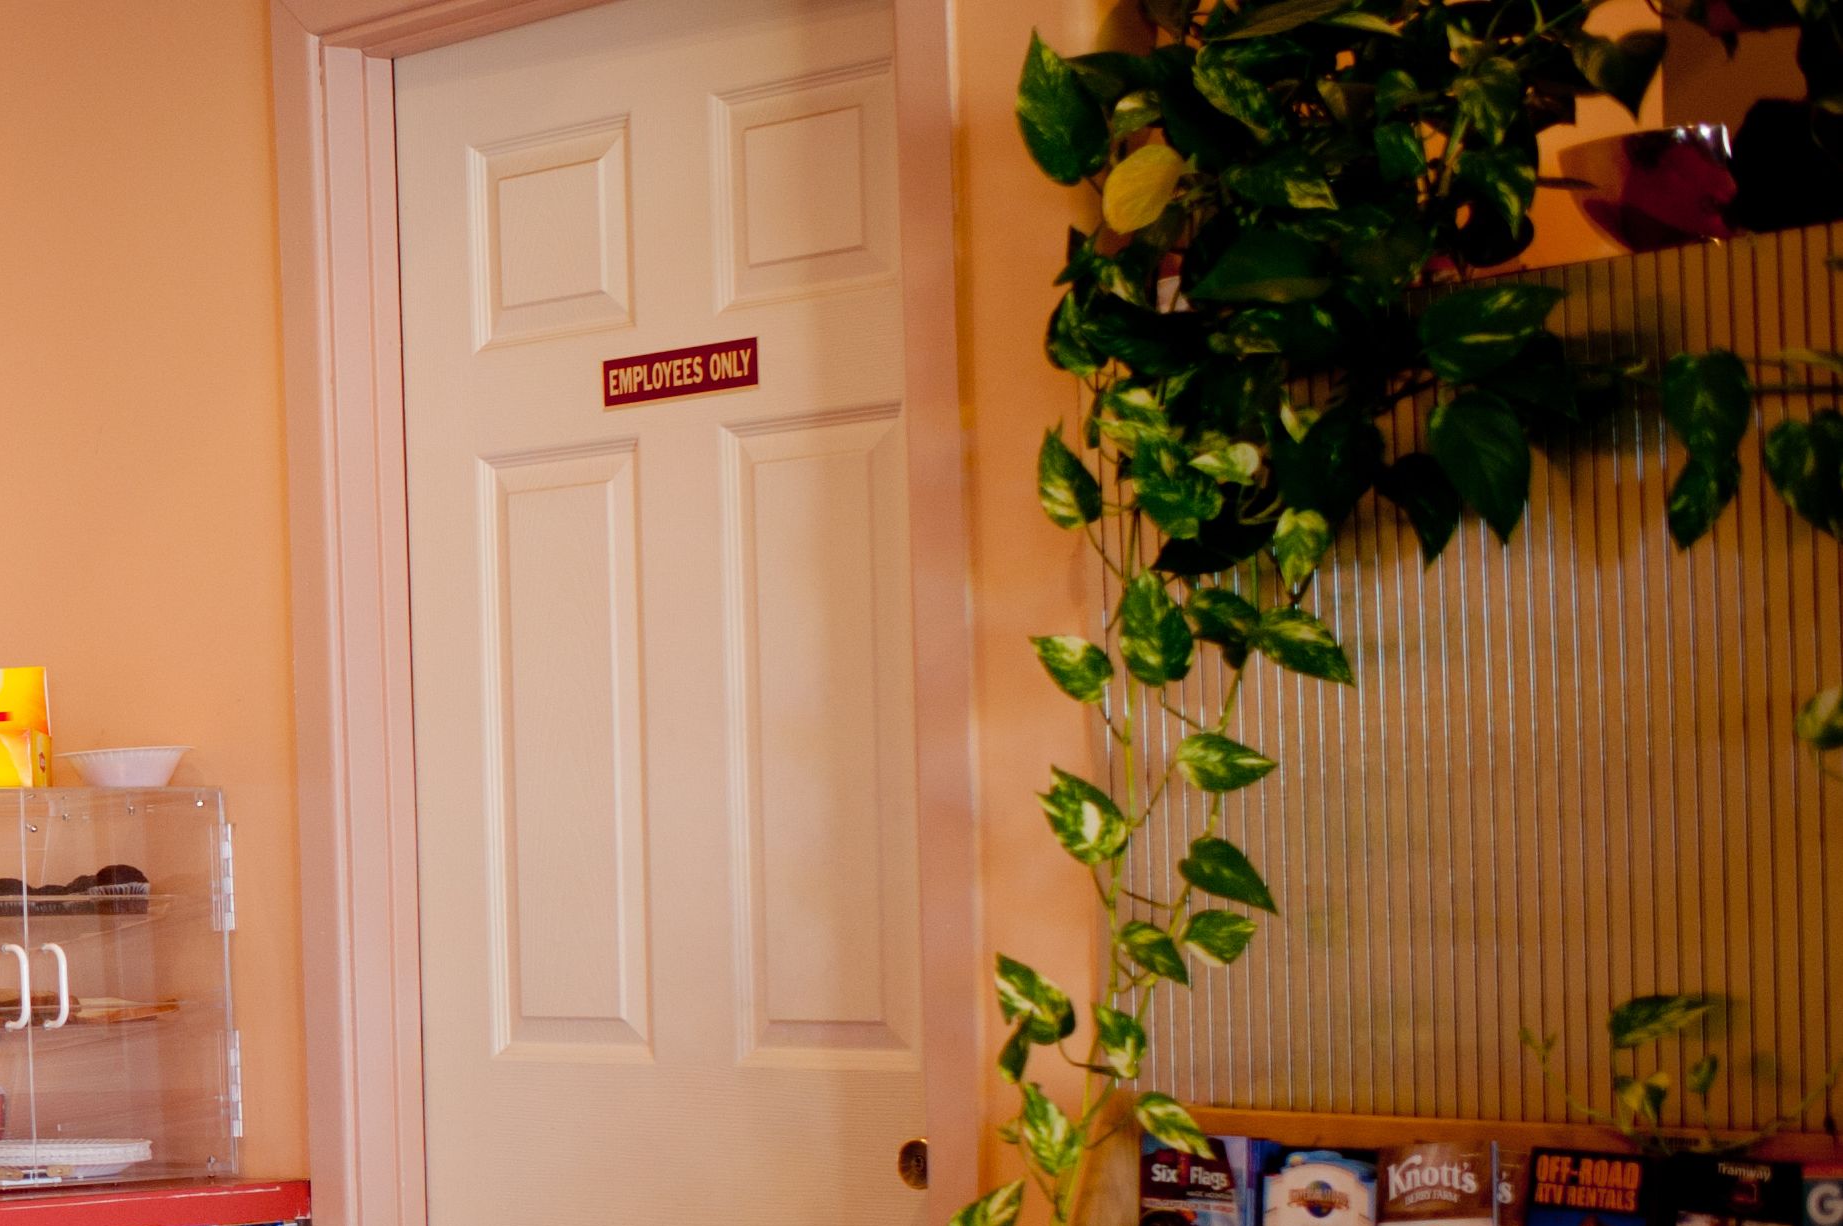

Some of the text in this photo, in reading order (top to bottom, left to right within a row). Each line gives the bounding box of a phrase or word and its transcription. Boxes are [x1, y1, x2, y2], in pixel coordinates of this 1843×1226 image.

[609, 349, 751, 396] EMPLOYEES ONLY
[1150, 1162, 1231, 1190] Six Flags
[1386, 1153, 1479, 1201] Knott's
[1534, 1154, 1641, 1189] OFF-ROAD
[1716, 1160, 1772, 1183] Tramway
[1565, 1185, 1638, 1212] RENTALS
